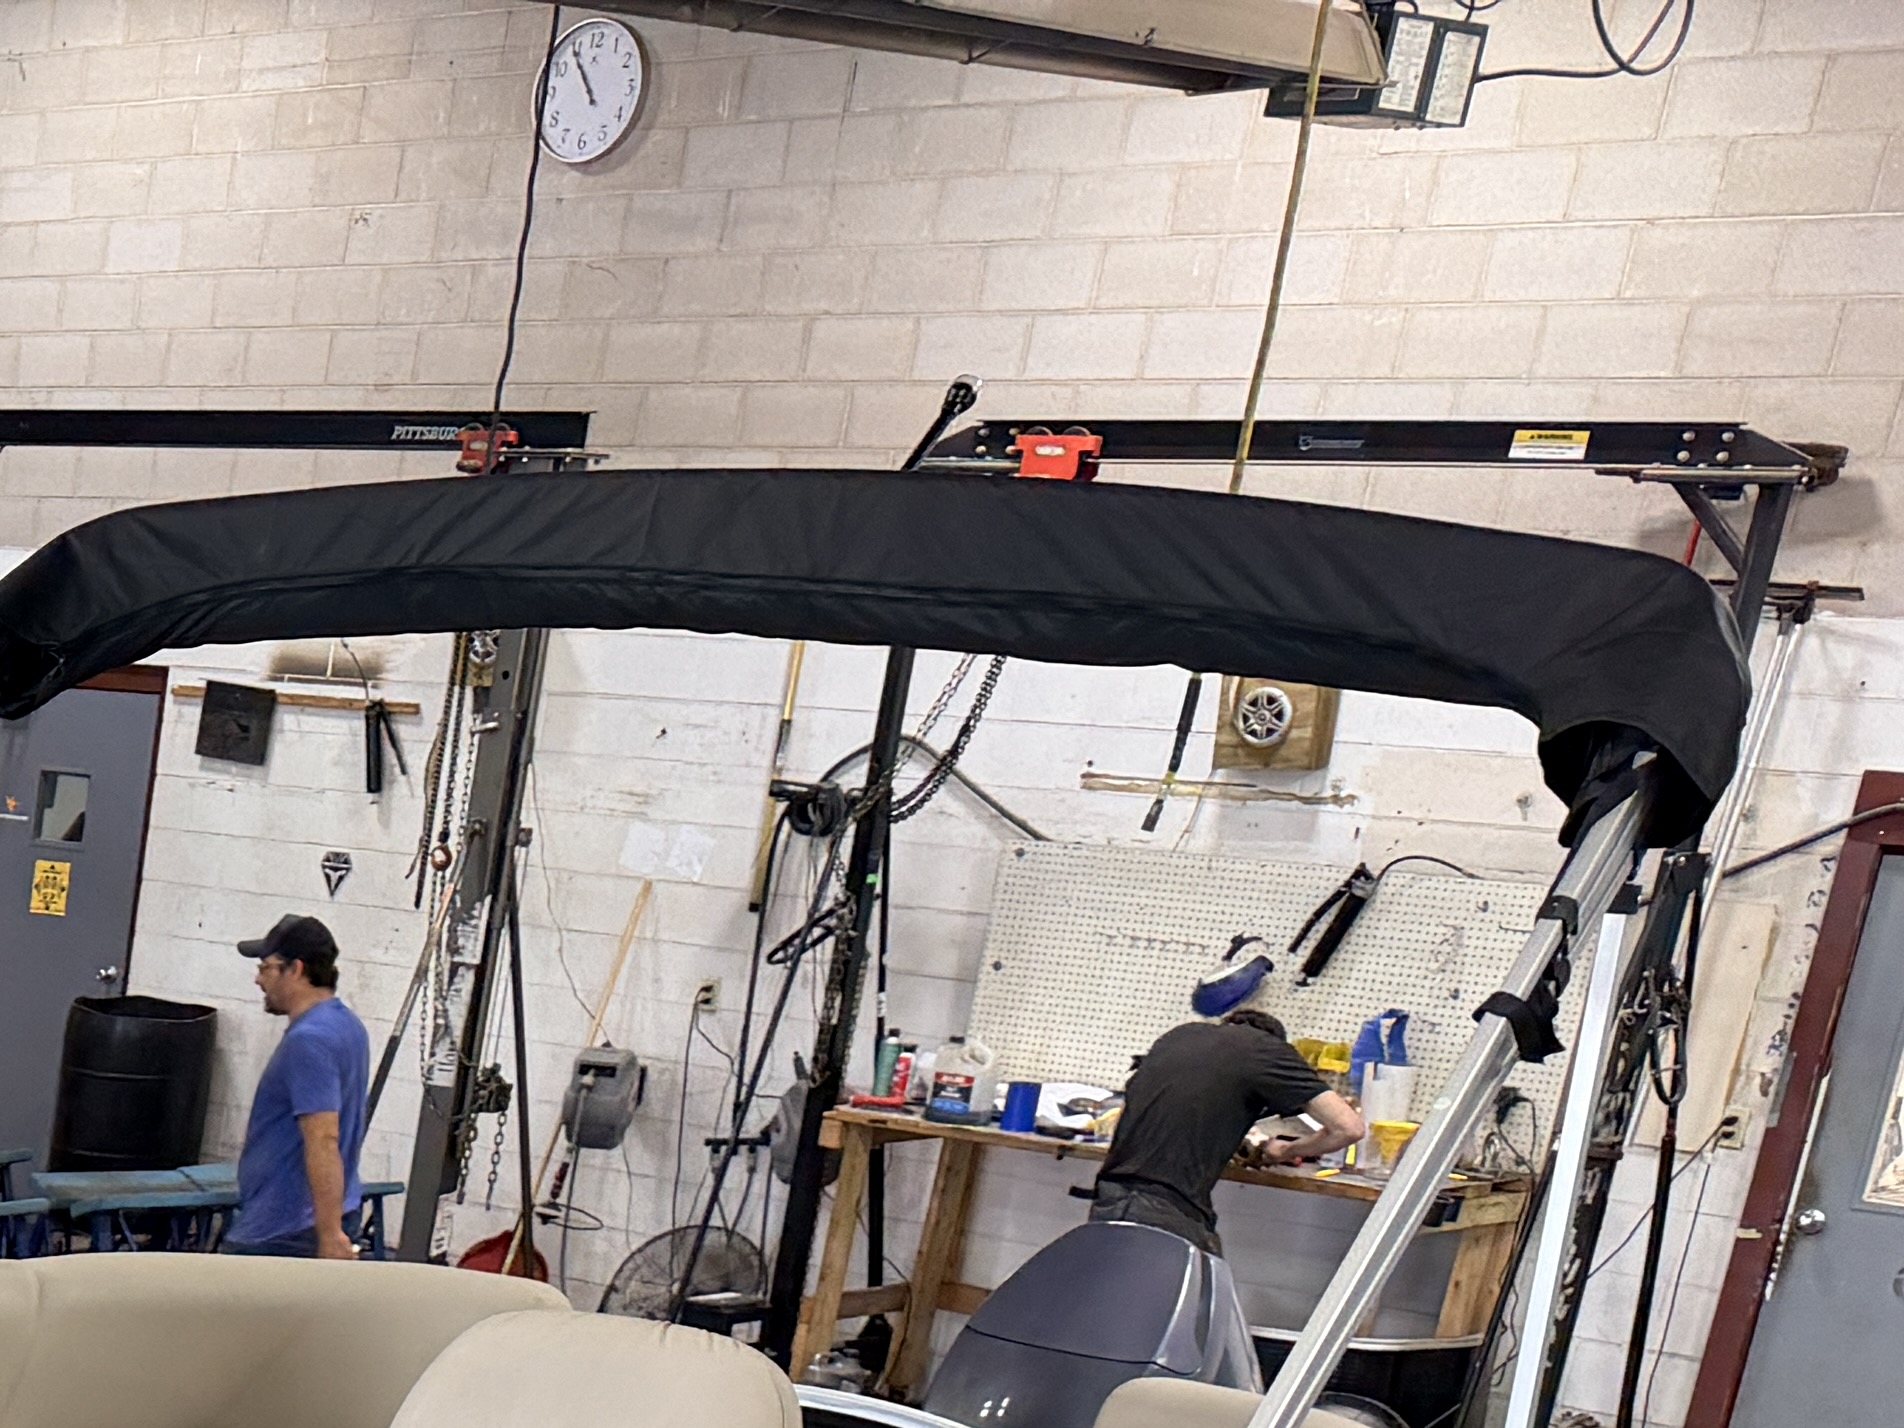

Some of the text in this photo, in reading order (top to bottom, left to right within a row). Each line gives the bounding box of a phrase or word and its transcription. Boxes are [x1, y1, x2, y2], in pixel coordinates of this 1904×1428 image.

[590, 31, 605, 48] 12
[622, 52, 632, 68] 2
[552, 60, 568, 78] 10
[624, 78, 635, 97] 3
[549, 110, 560, 128] 8
[614, 105, 623, 122] 4
[561, 128, 571, 144] 7
[577, 133, 586, 150] 6
[597, 124, 608, 142] 5
[391, 425, 459, 440] PITTSBUR
